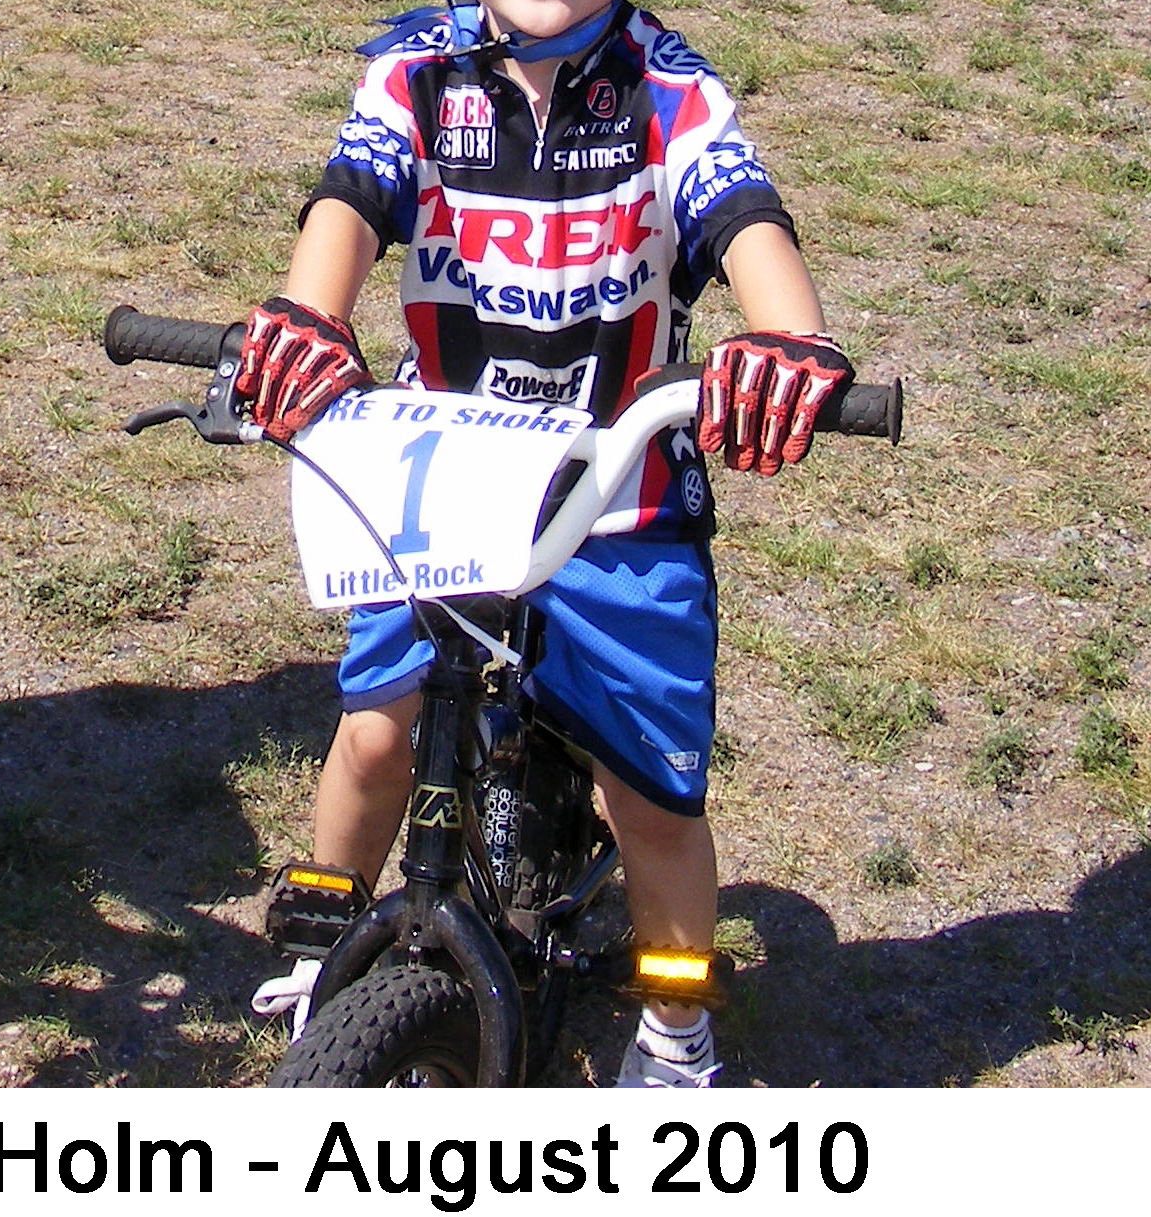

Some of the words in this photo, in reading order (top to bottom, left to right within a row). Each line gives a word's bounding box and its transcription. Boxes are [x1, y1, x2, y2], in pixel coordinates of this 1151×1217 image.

[688, 166, 771, 219] Volksw
[418, 185, 656, 269] TREK
[490, 364, 588, 399] PowerB
[392, 402, 437, 422] TO
[451, 408, 583, 435] SHORE
[389, 430, 444, 555] 1
[325, 568, 402, 598] Little
[415, 558, 484, 589] Rock
